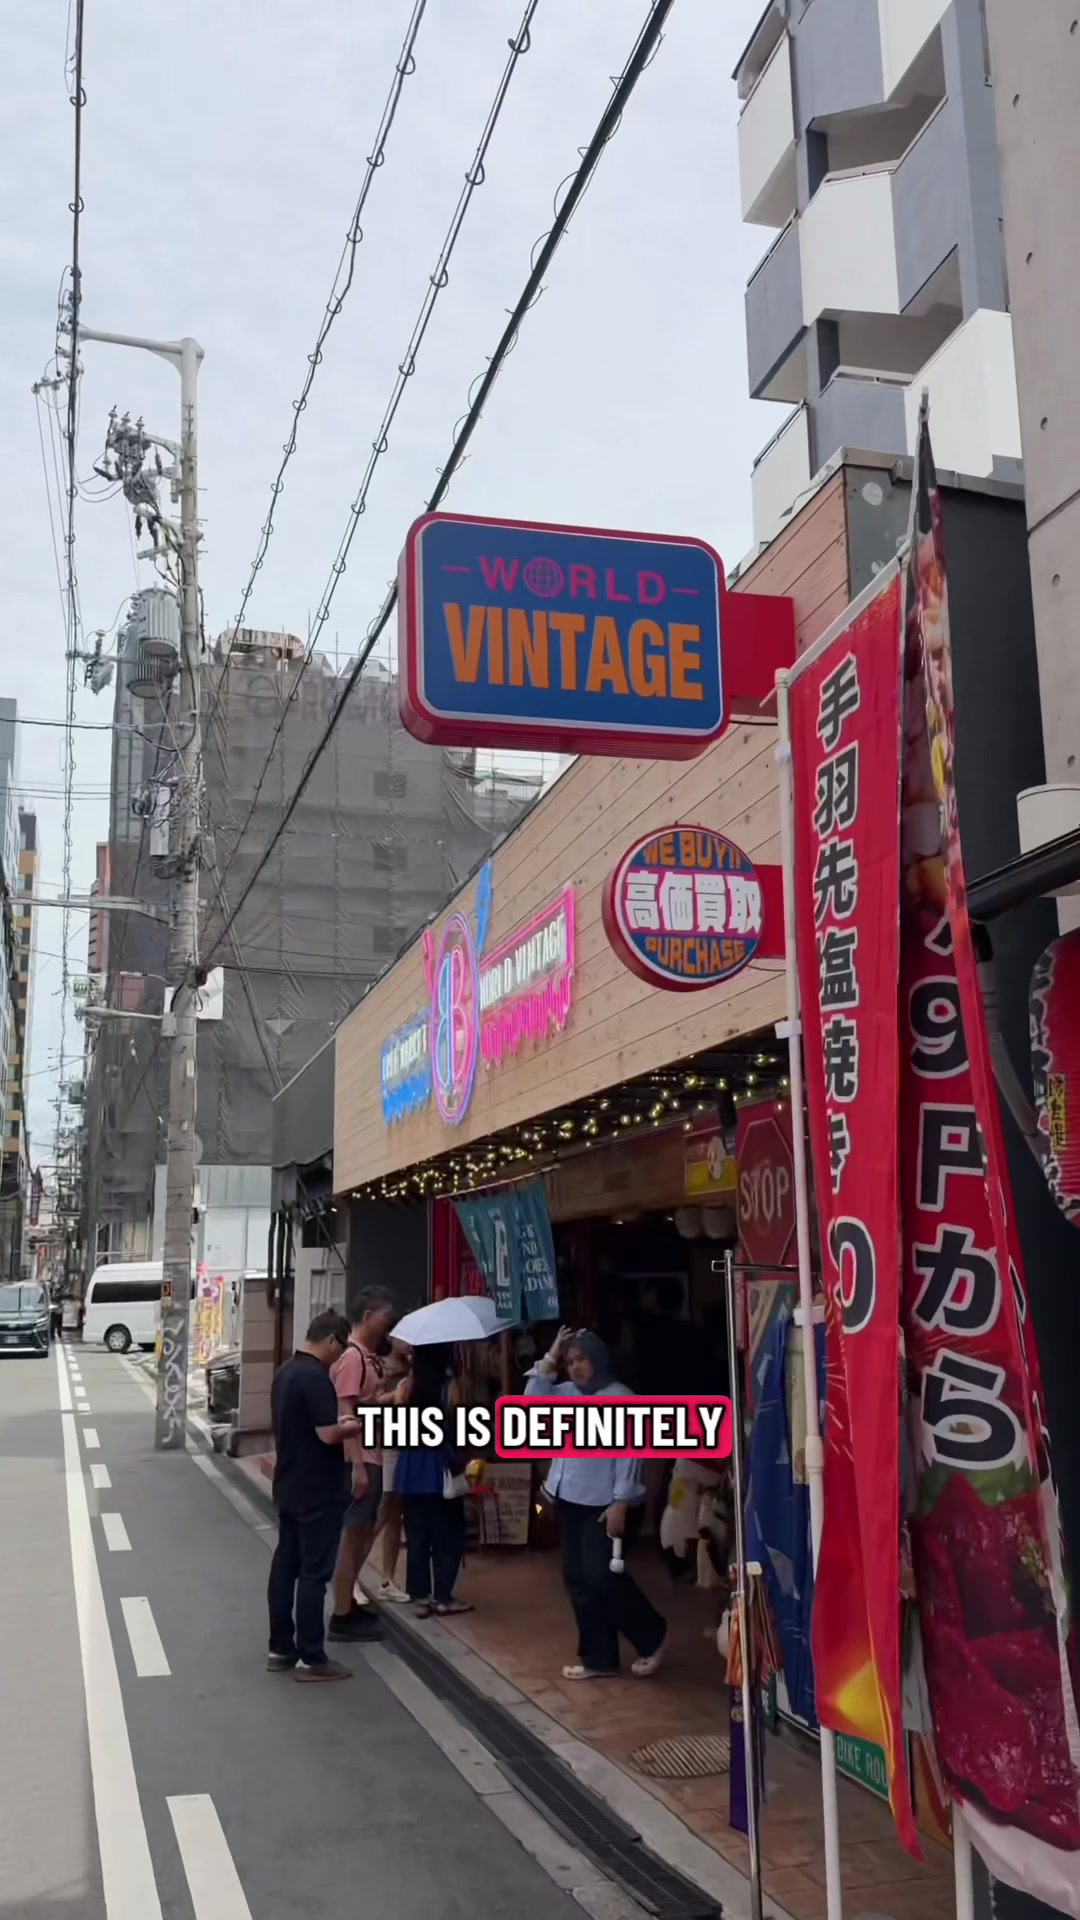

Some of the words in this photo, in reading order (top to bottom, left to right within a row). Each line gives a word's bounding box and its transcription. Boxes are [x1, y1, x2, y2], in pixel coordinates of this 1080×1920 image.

[478, 555, 667, 605] WORLD
[443, 602, 704, 700] VINTAGE
[641, 833, 676, 866] WE
[624, 870, 762, 934] 高価買取
[515, 913, 567, 985] VINTAGE
[645, 936, 746, 975] PURCHASE
[740, 1164, 789, 1222] STOP
[836, 1735, 861, 1773] BIKE
